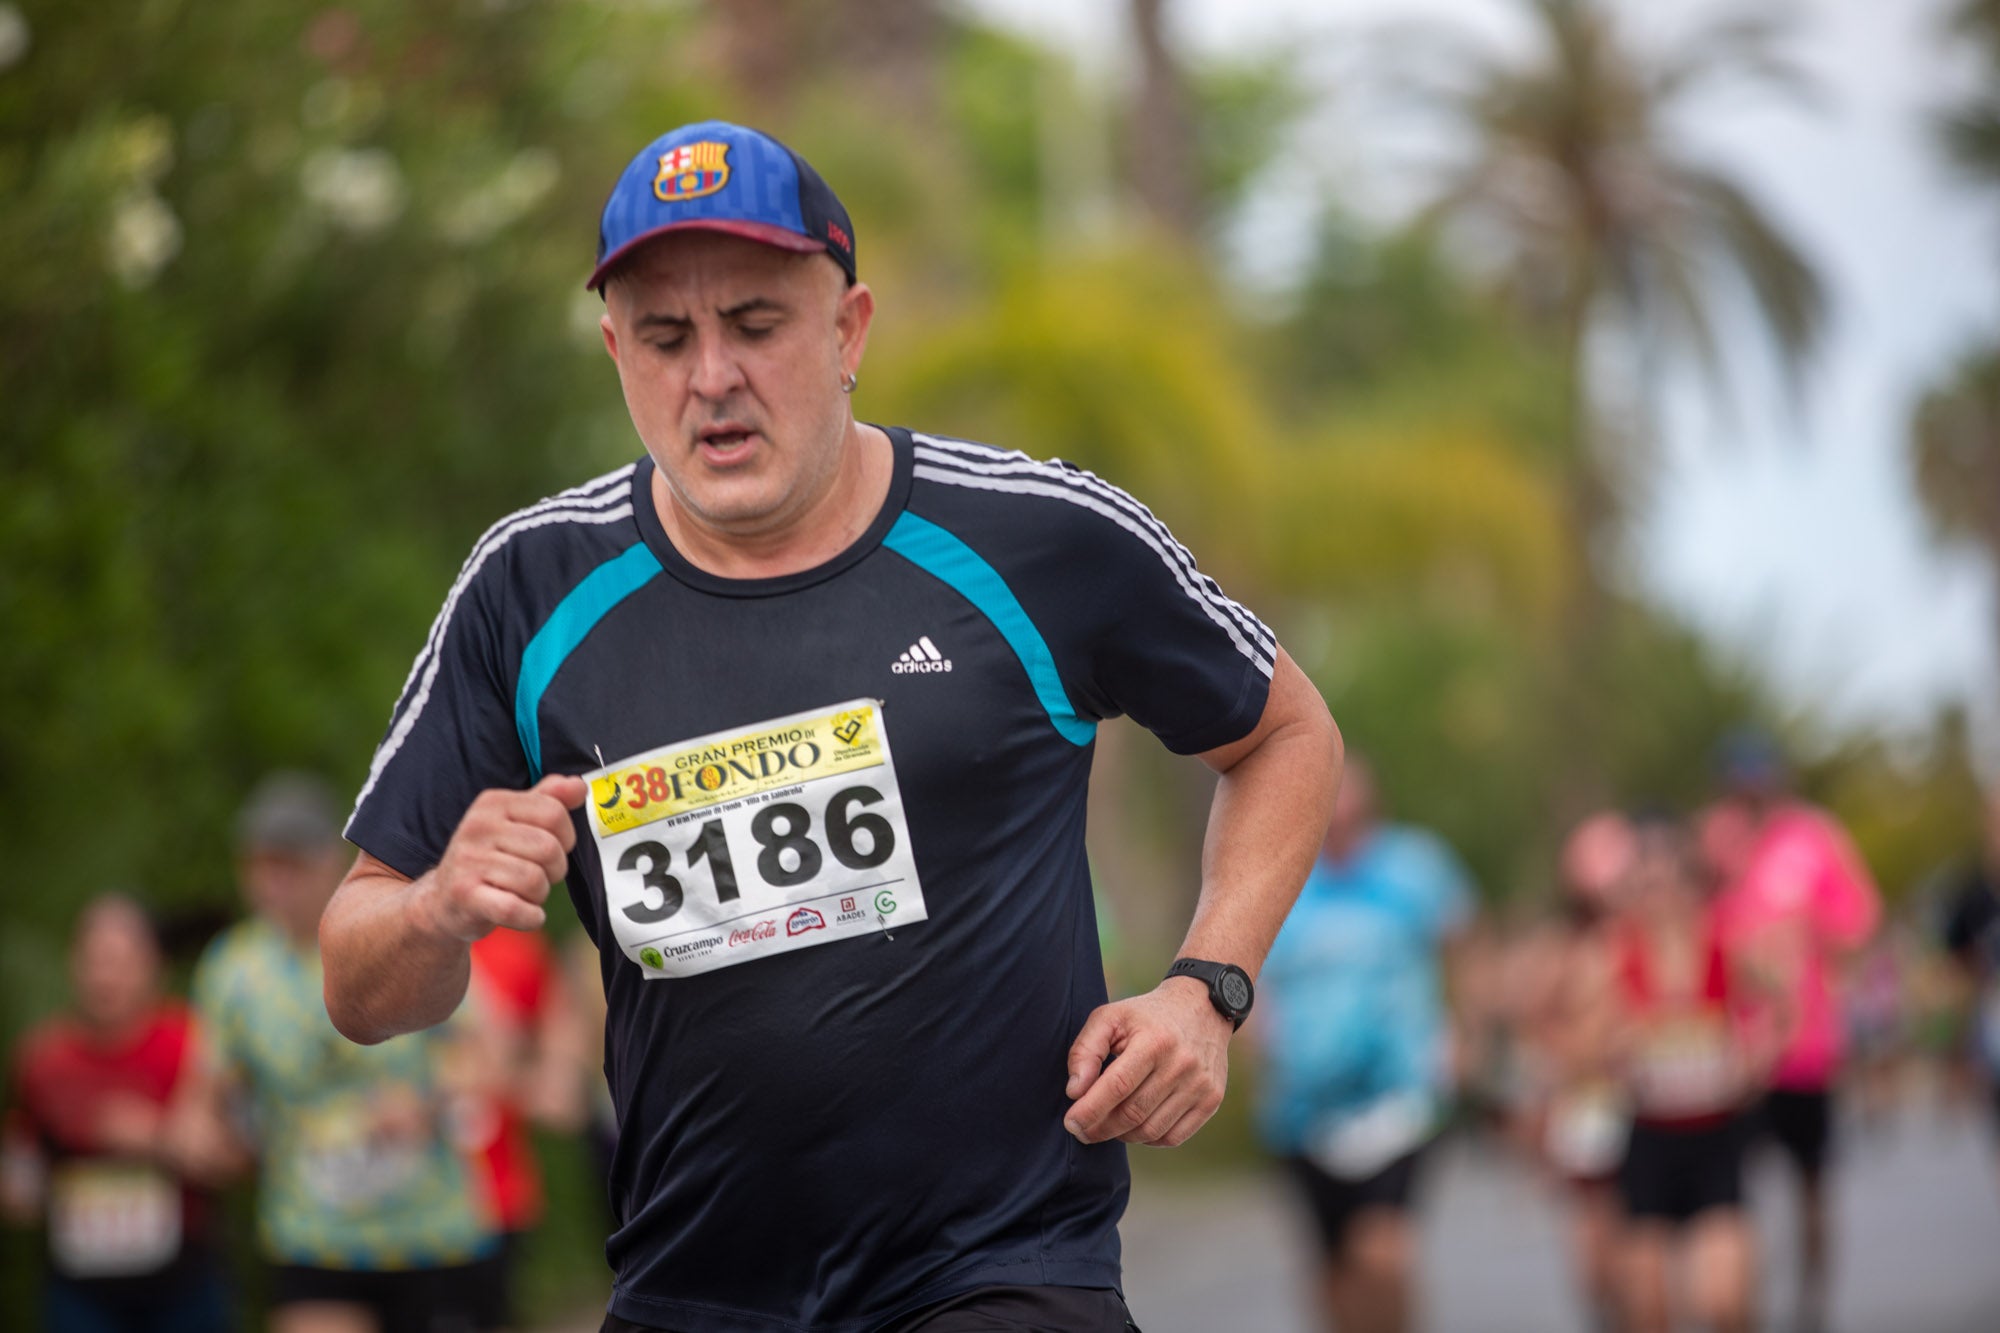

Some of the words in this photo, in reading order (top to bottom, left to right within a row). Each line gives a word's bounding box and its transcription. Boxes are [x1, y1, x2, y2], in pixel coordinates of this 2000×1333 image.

[891, 659, 952, 674] adidas
[674, 747, 727, 770] GRAN
[731, 729, 803, 757] PREMIO
[626, 766, 671, 809] 38
[669, 741, 822, 801] FONDO
[616, 784, 896, 926] 3186
[836, 910, 866, 923] ABADES
[663, 936, 724, 960] Cruzcampo
